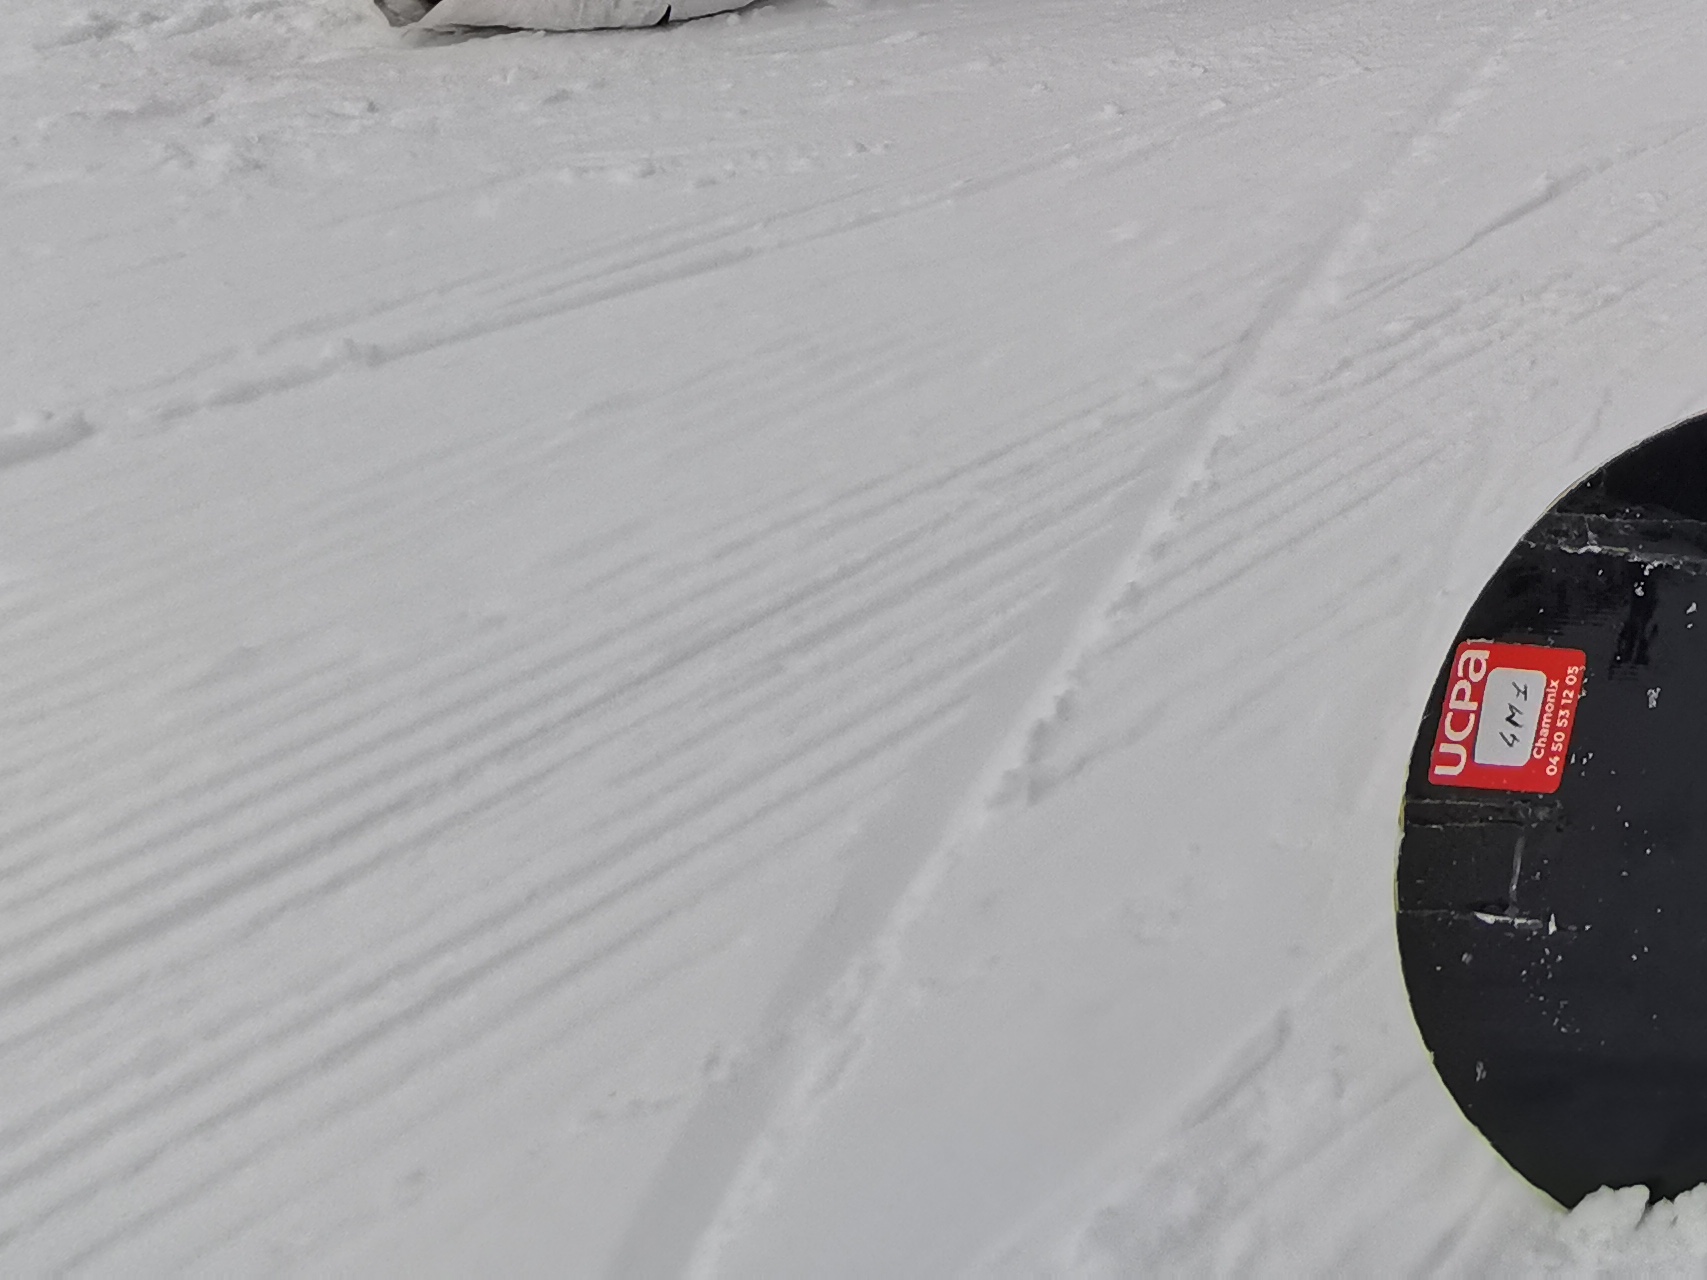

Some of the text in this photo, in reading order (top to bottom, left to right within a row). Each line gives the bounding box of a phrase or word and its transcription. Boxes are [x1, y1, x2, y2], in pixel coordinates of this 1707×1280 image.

[1532, 678, 1560, 760] Chamonix
[1545, 665, 1580, 776] 04 50 53 12 05
